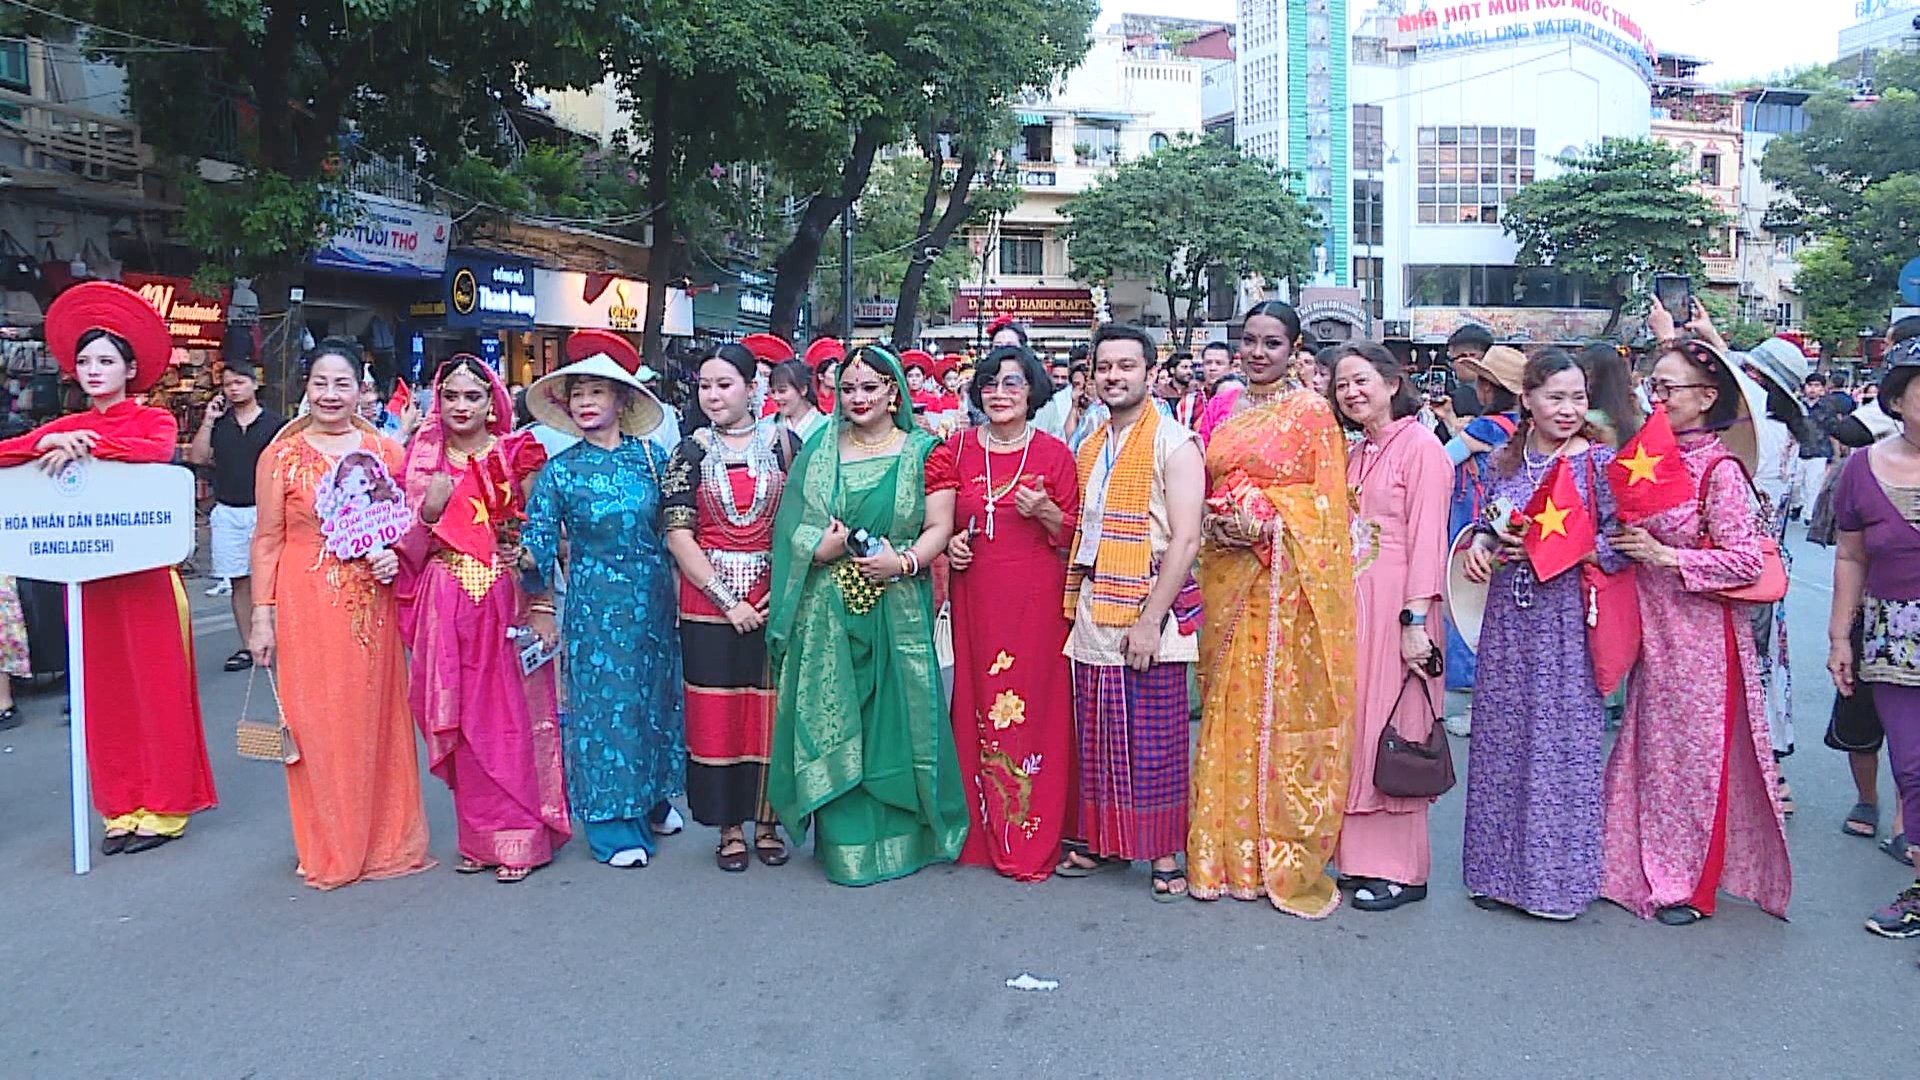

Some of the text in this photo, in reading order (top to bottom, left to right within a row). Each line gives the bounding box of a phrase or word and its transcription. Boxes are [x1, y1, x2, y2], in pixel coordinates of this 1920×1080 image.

[968, 298, 992, 310] DN
[32, 511, 65, 529] NHÂN
[68, 510, 92, 528] DÂN
[95, 511, 172, 527] BANGLADESH
[29, 539, 114, 556] (BANGLADESH)
[350, 525, 397, 554] 20-10
